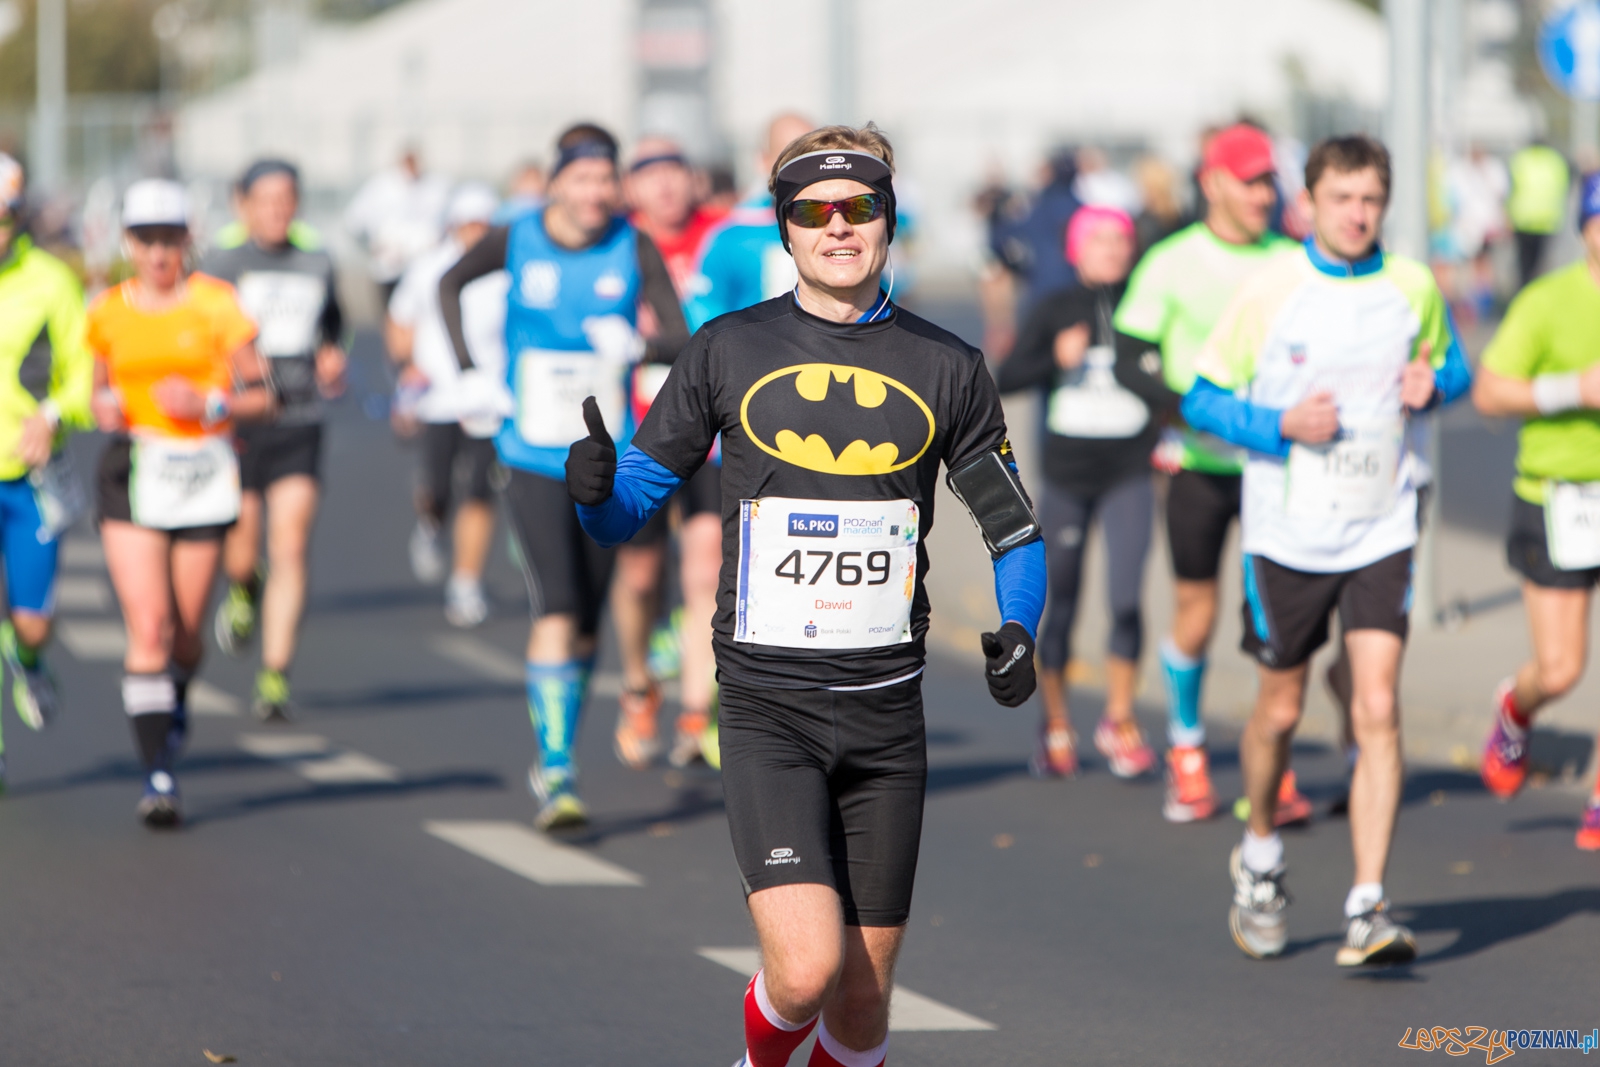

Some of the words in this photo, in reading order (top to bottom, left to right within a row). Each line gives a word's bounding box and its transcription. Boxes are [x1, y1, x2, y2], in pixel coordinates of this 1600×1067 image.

[791, 519, 808, 531] 16.
[809, 521, 835, 532] PKO
[843, 526, 882, 534] maraton
[774, 549, 891, 586] 4769
[815, 599, 852, 610] Dawid
[765, 856, 801, 866] Kalenji
